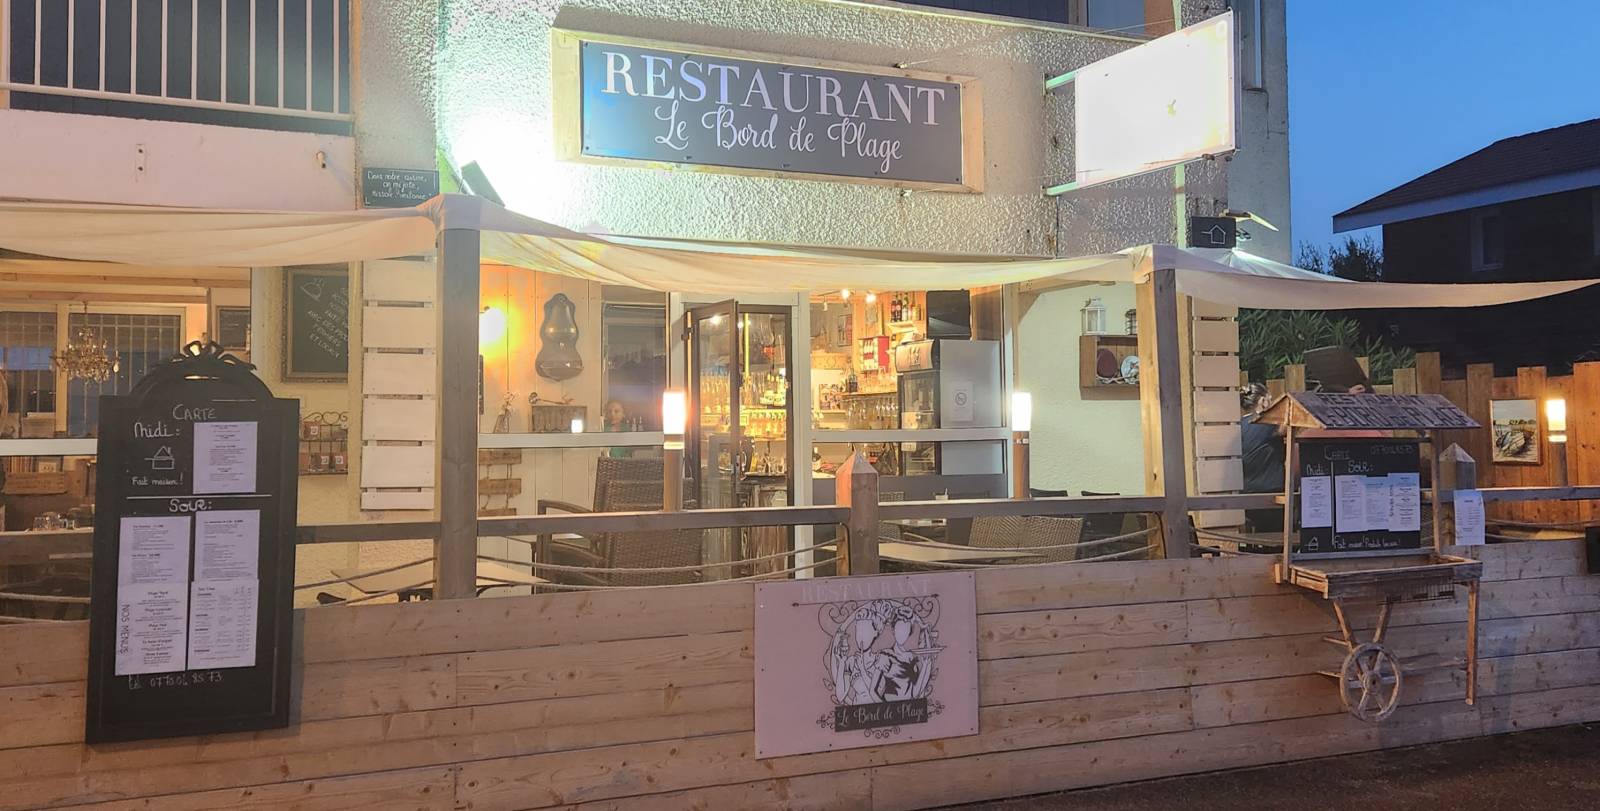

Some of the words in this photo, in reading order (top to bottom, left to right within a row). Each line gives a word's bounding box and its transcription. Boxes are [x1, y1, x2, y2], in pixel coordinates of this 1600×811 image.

[600, 51, 945, 126] RESTAURANT
[654, 100, 689, 151] Le
[701, 104, 779, 151] Bord
[788, 116, 816, 153] de
[827, 117, 903, 174] Plage
[801, 579, 930, 601] RESTAURANT
[837, 707, 849, 727] Le
[853, 705, 880, 724] Bord
[883, 705, 893, 720] de
[897, 702, 924, 721] Plage
